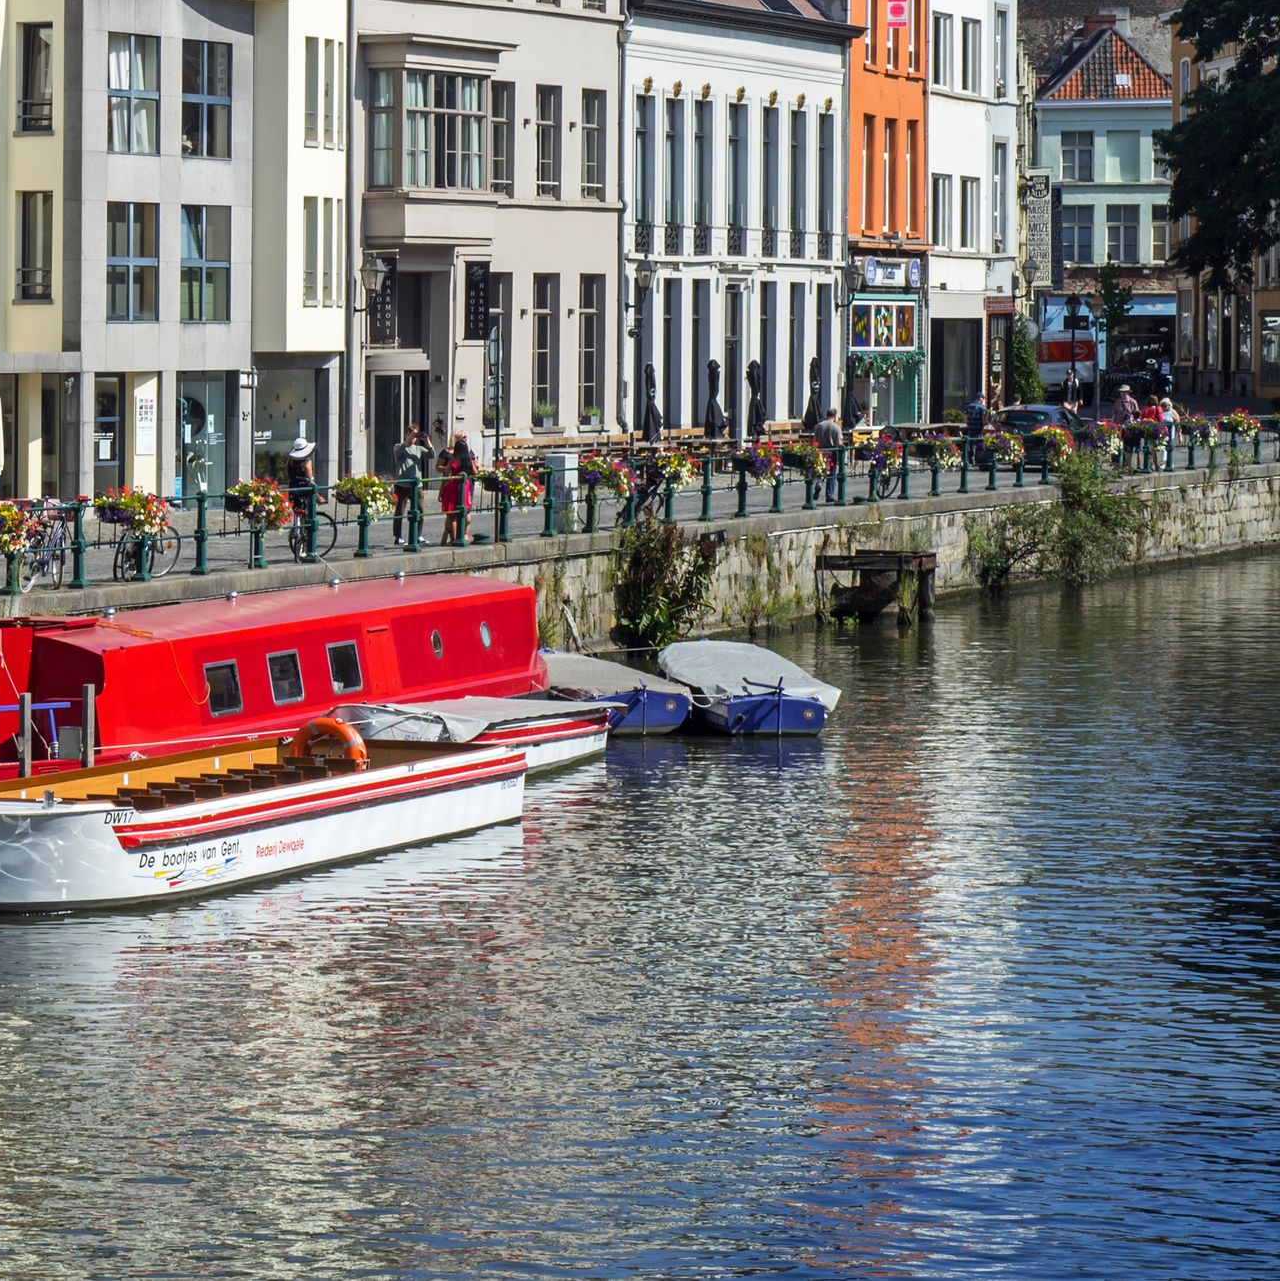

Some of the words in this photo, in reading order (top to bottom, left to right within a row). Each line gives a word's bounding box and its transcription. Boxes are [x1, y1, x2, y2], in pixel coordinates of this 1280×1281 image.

[104, 812, 134, 825] DW17
[139, 853, 155, 868] De
[202, 847, 216, 859] van
[221, 842, 240, 857] Gent
[255, 844, 278, 858] Rederij
